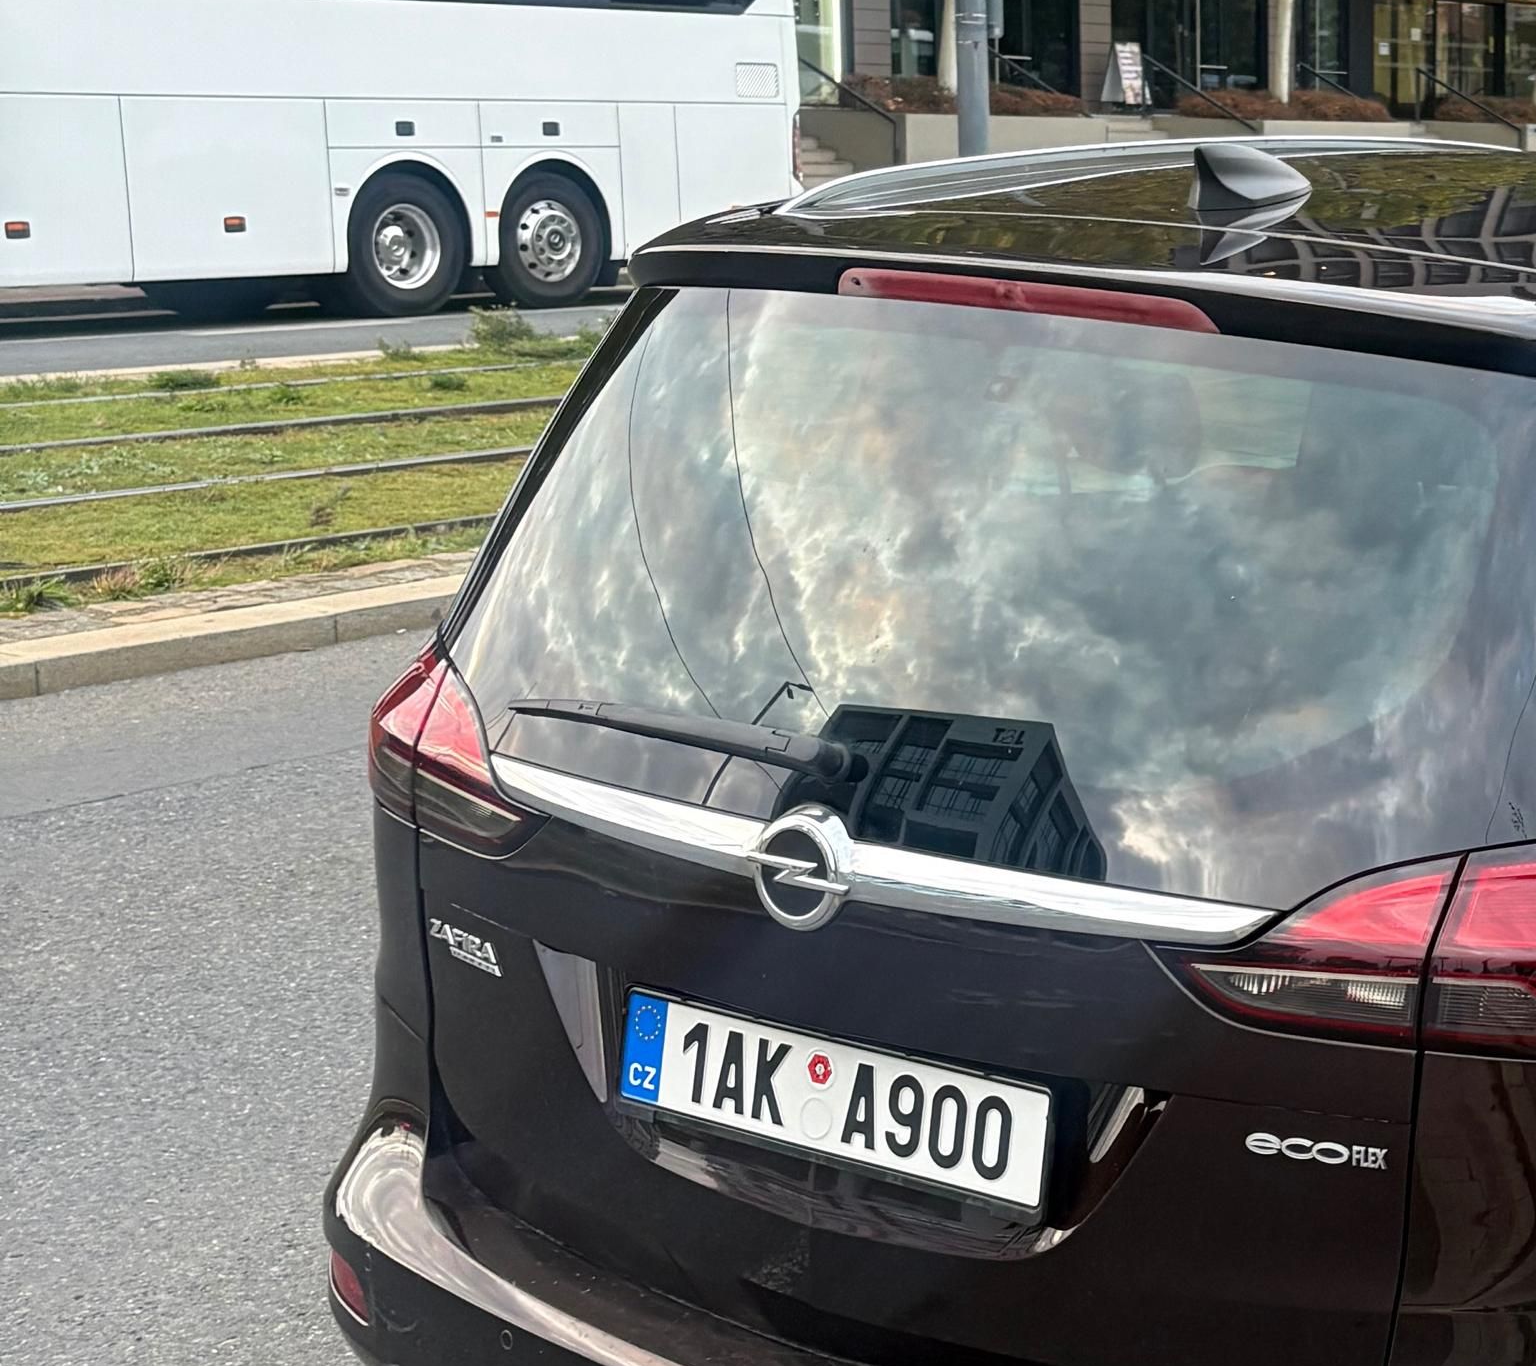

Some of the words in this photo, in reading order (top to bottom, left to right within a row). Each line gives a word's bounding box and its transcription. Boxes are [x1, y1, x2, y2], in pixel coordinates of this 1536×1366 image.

[430, 918, 497, 965] ZAFIRA
[629, 1062, 657, 1091] CZ
[682, 1022, 793, 1127] 1AK
[840, 1062, 1013, 1181] A900
